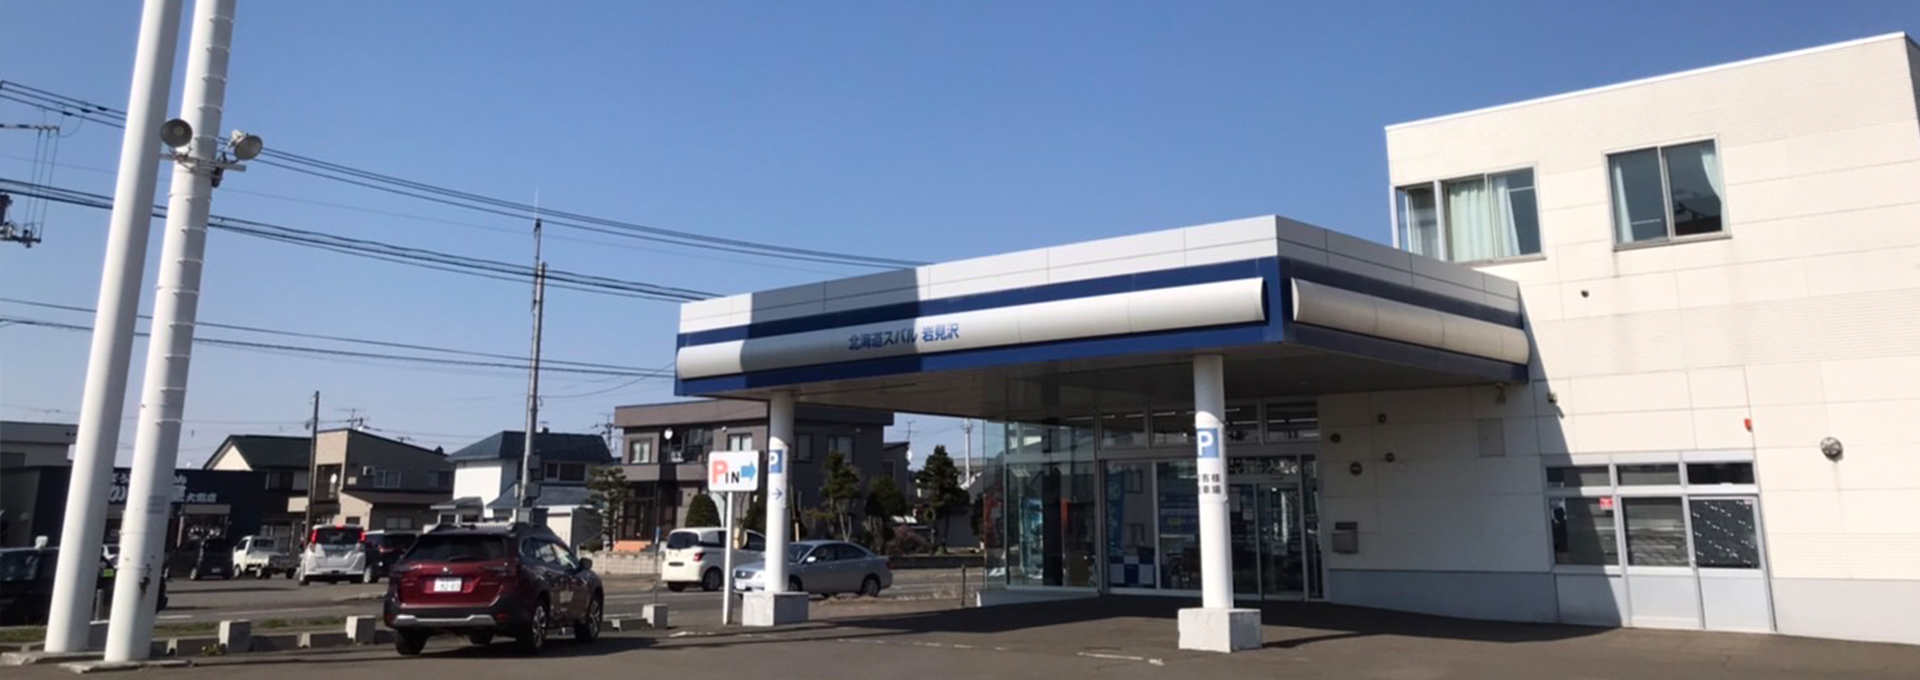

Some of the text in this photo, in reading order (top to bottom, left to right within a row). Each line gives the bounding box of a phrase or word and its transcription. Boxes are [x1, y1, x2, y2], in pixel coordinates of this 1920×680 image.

[848, 323, 960, 351] 北海道スバル 岩見沢
[1197, 431, 1213, 456] P
[1199, 473, 1220, 483] 客様
